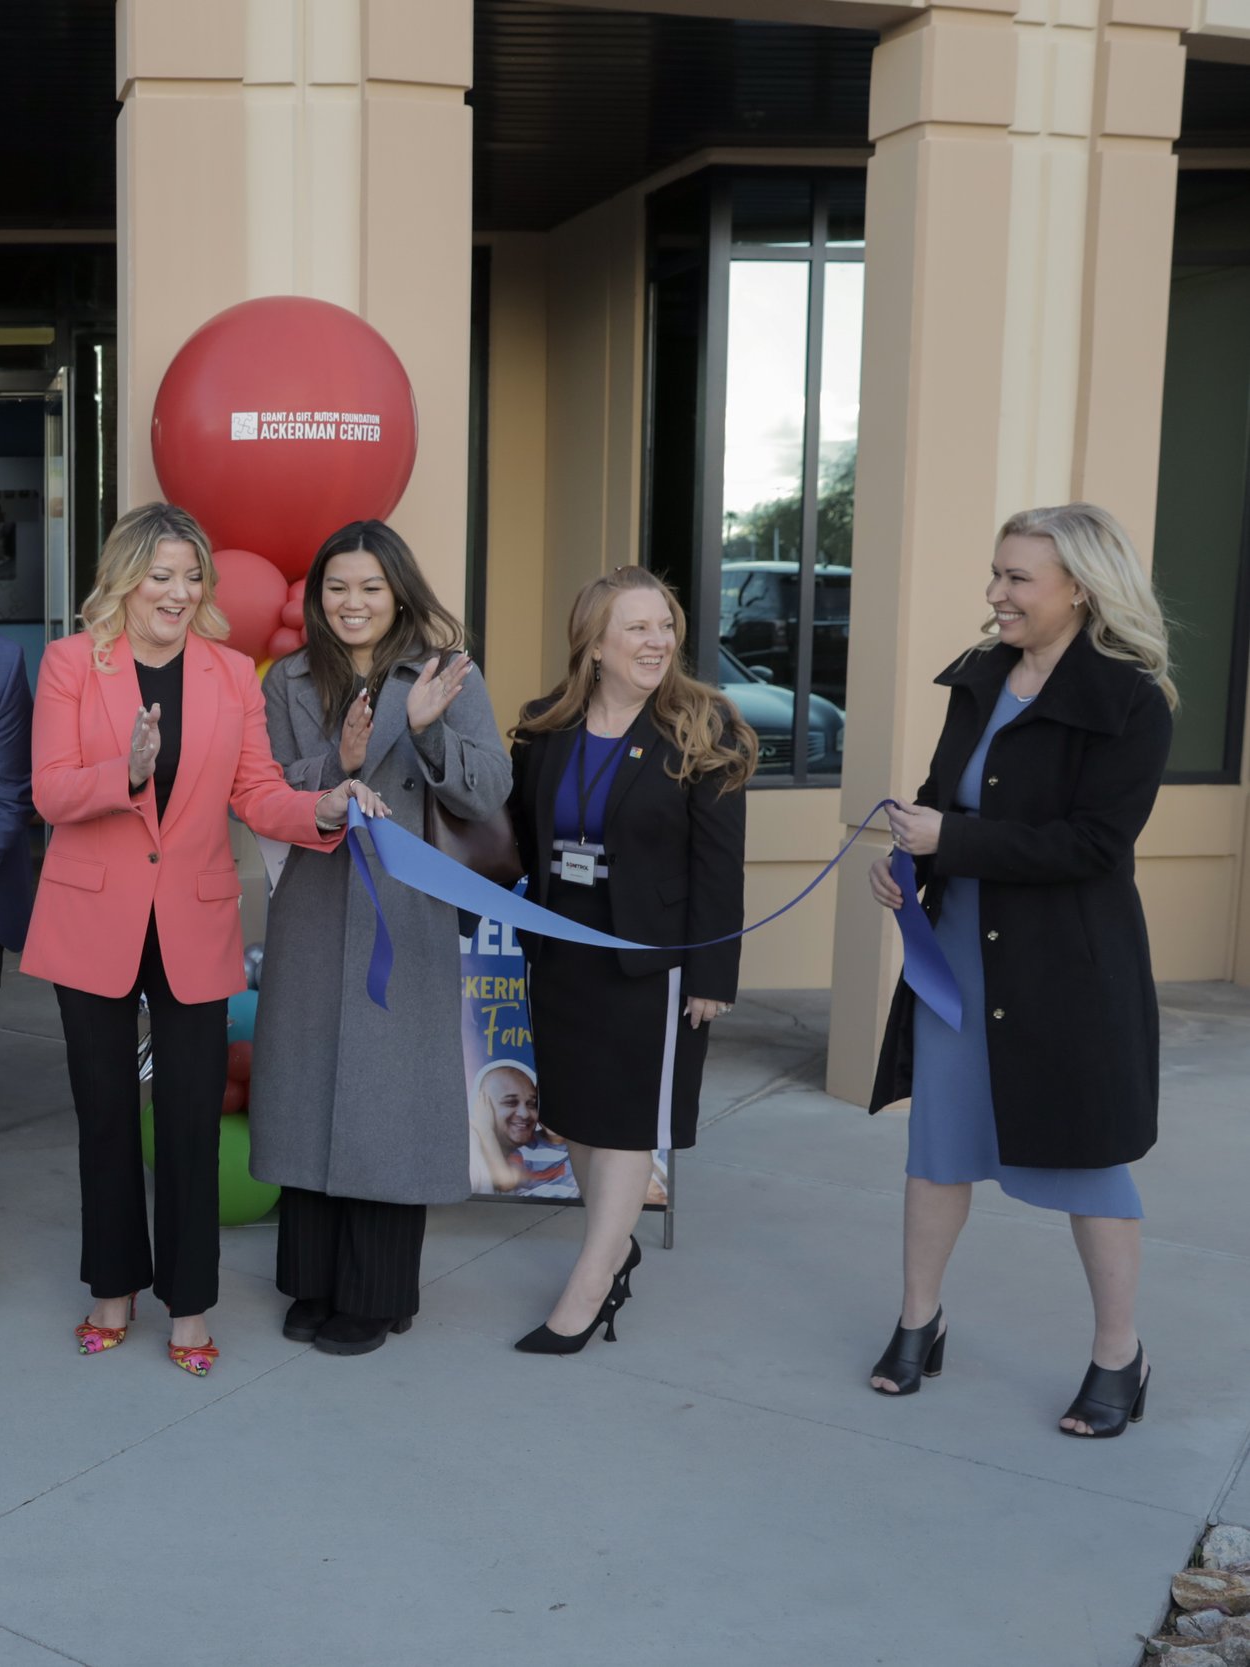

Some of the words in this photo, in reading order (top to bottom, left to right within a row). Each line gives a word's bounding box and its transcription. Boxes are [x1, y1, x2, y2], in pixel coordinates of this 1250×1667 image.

[261, 412, 287, 422] GRANT
[288, 412, 294, 422] A
[314, 412, 339, 422] AUTISM
[341, 412, 380, 424] FOUNDATION
[260, 423, 336, 440] ACKERMAN
[339, 424, 381, 442] CENTER
[462, 976, 526, 1000] KERM
